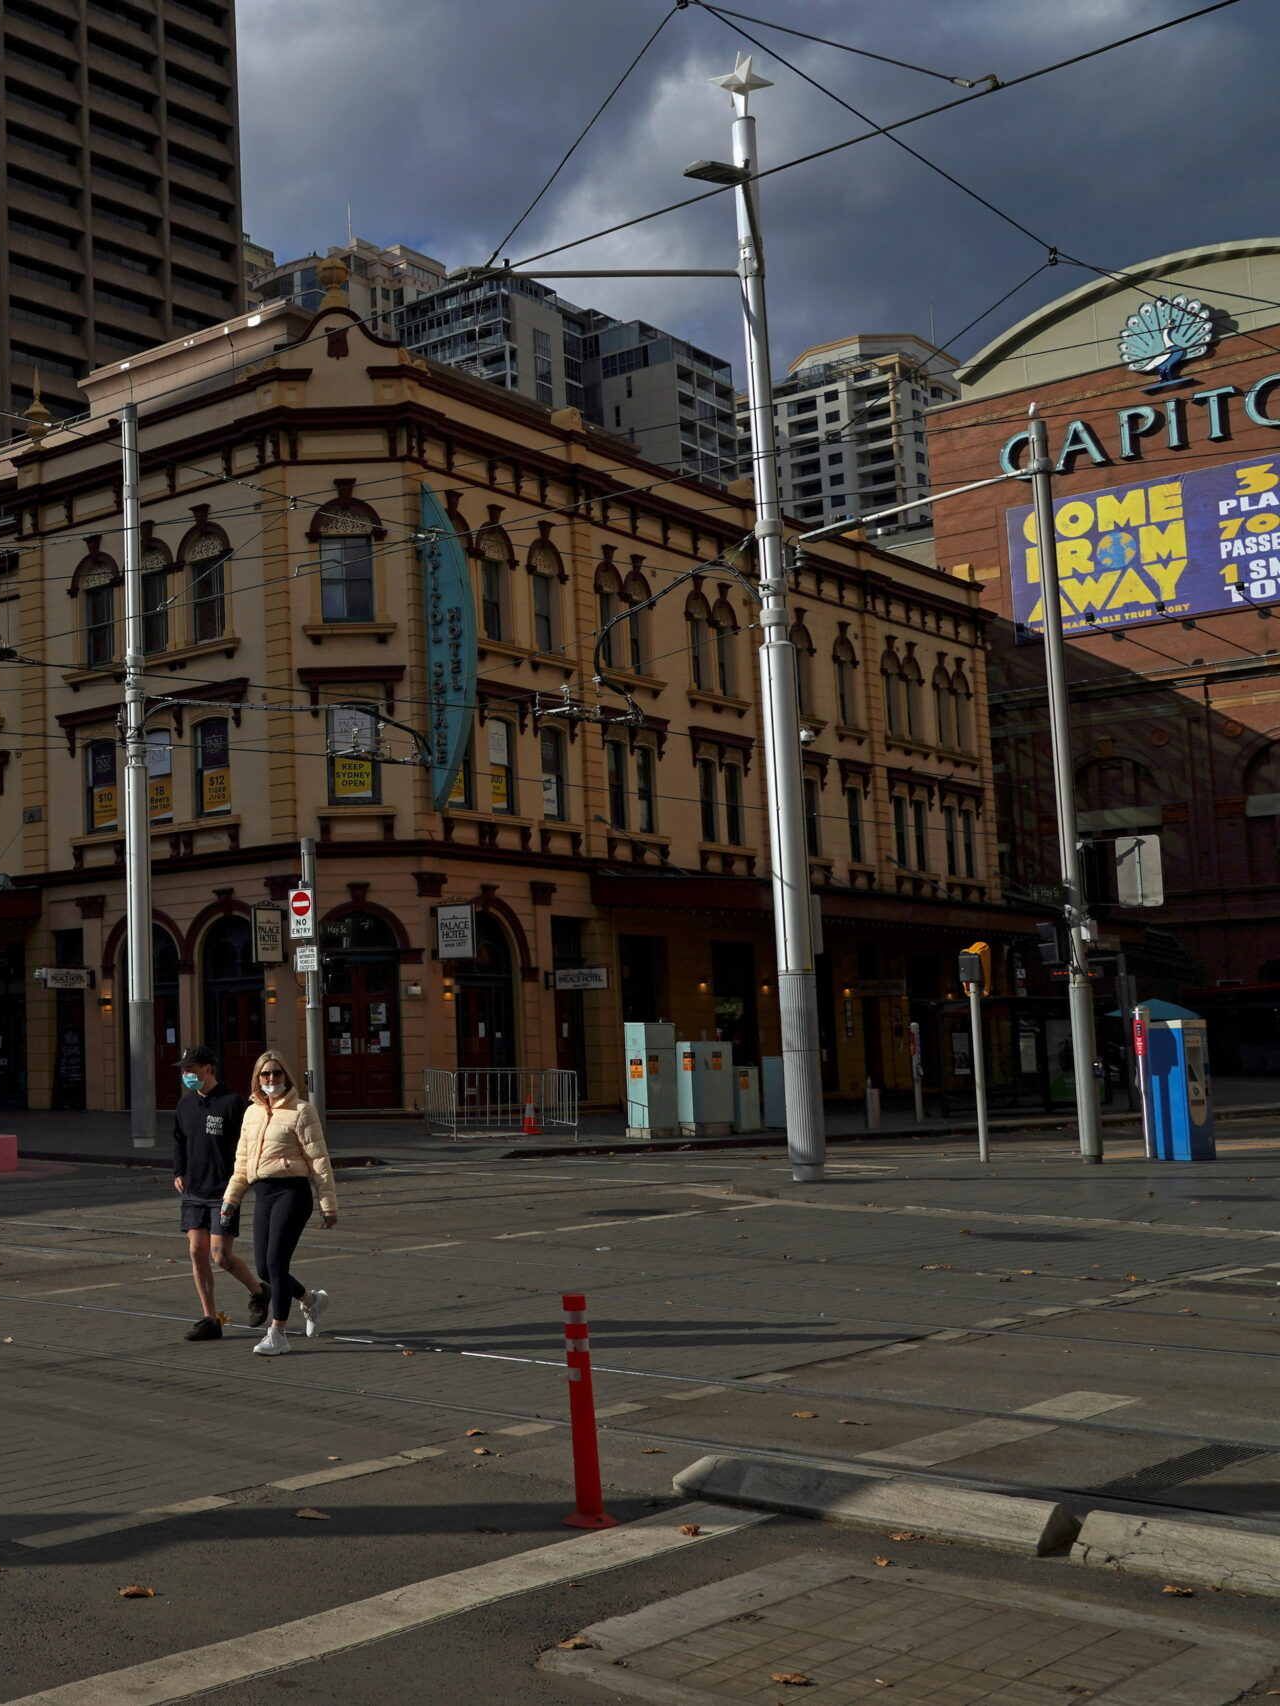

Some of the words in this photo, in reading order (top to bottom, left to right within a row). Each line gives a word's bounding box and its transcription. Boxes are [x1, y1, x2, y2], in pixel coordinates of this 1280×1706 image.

[1235, 463, 1279, 495] 3
[1219, 491, 1280, 515] PLA
[1219, 563, 1238, 584] 1
[1124, 609, 1152, 620] TRUE
[447, 607, 463, 691] HOTEL
[432, 662, 449, 764] SQUARE
[342, 763, 364, 771] KEEP
[336, 771, 370, 779] SYDNEY
[209, 775, 225, 787] $12
[341, 779, 365, 787] OPEN
[98, 792, 113, 803] $10
[296, 918, 307, 926] NO
[440, 921, 469, 930] PALACE
[257, 926, 280, 934] PALACE
[292, 927, 311, 935] ENTRY
[327, 924, 339, 936] Hay
[441, 930, 468, 939] HOTEL
[259, 934, 279, 943] HOTEL
